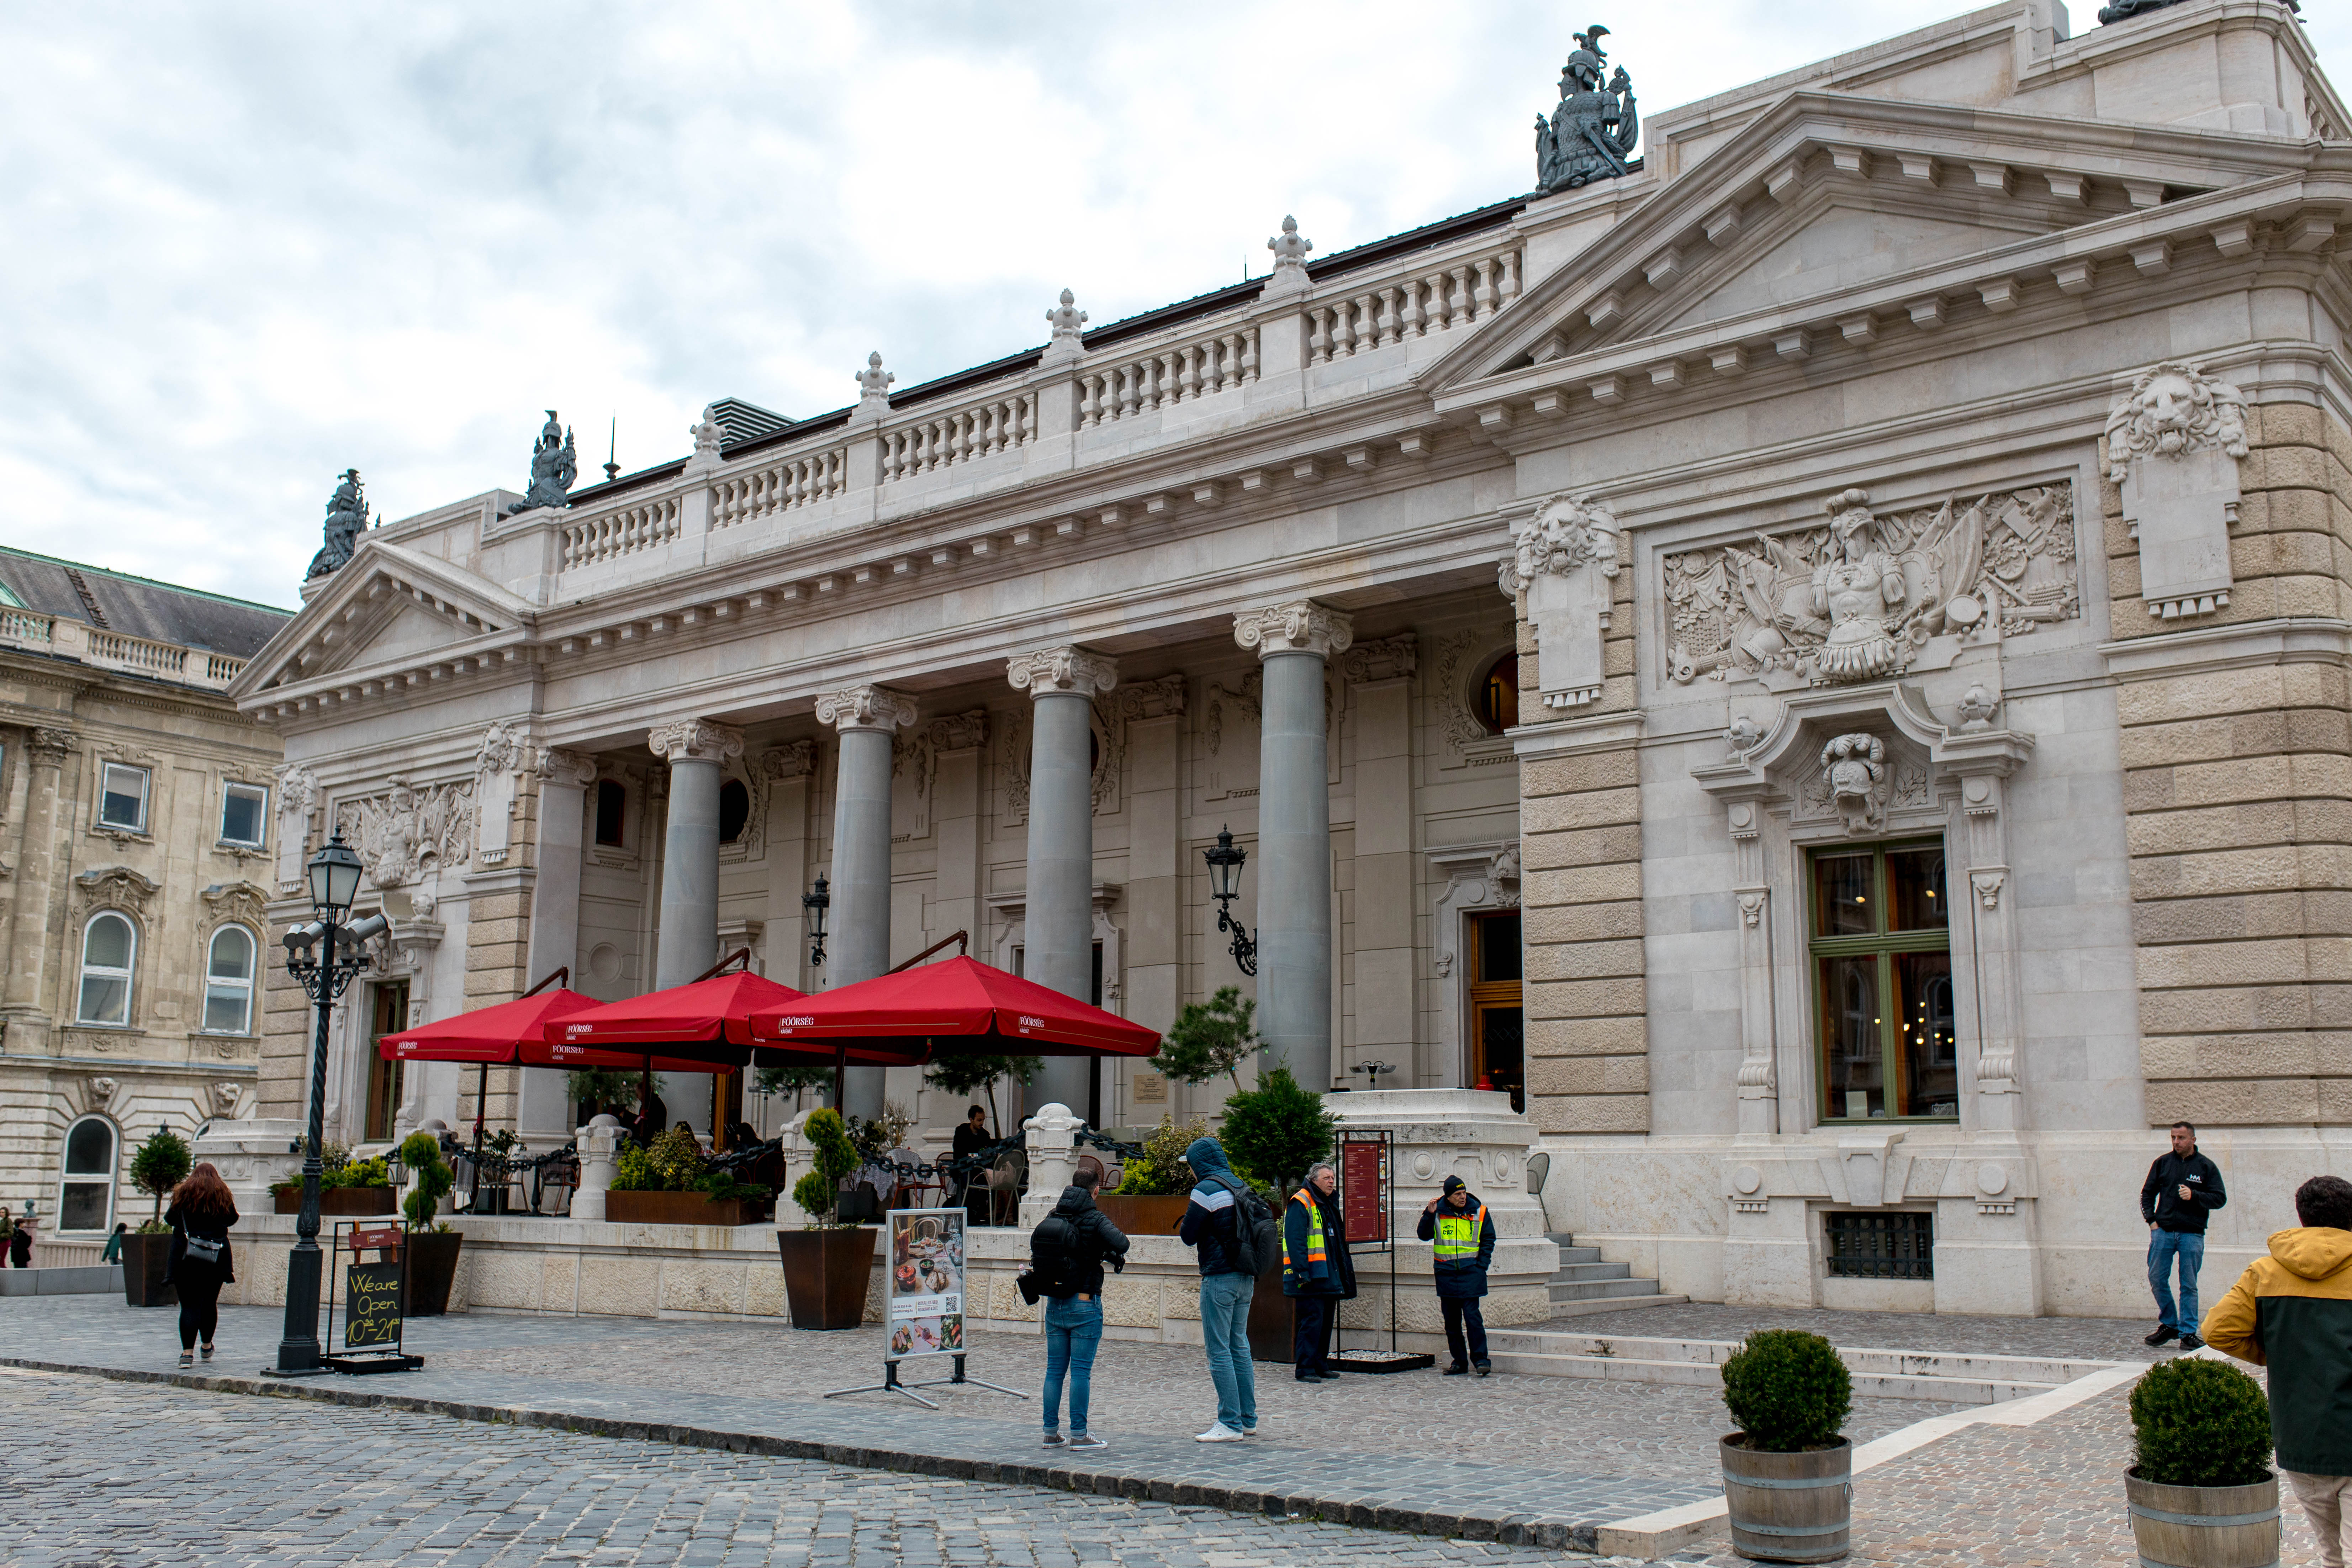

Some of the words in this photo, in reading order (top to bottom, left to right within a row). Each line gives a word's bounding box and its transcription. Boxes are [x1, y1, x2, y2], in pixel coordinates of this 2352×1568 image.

[782, 1016, 814, 1026] FŐŐRSÉG
[1020, 1016, 1044, 1028] FŐŐRSÉG
[568, 1024, 593, 1033] FŐŐRSÉG
[350, 1274, 374, 1293] We
[375, 1281, 398, 1291] are
[358, 1296, 398, 1318] Open
